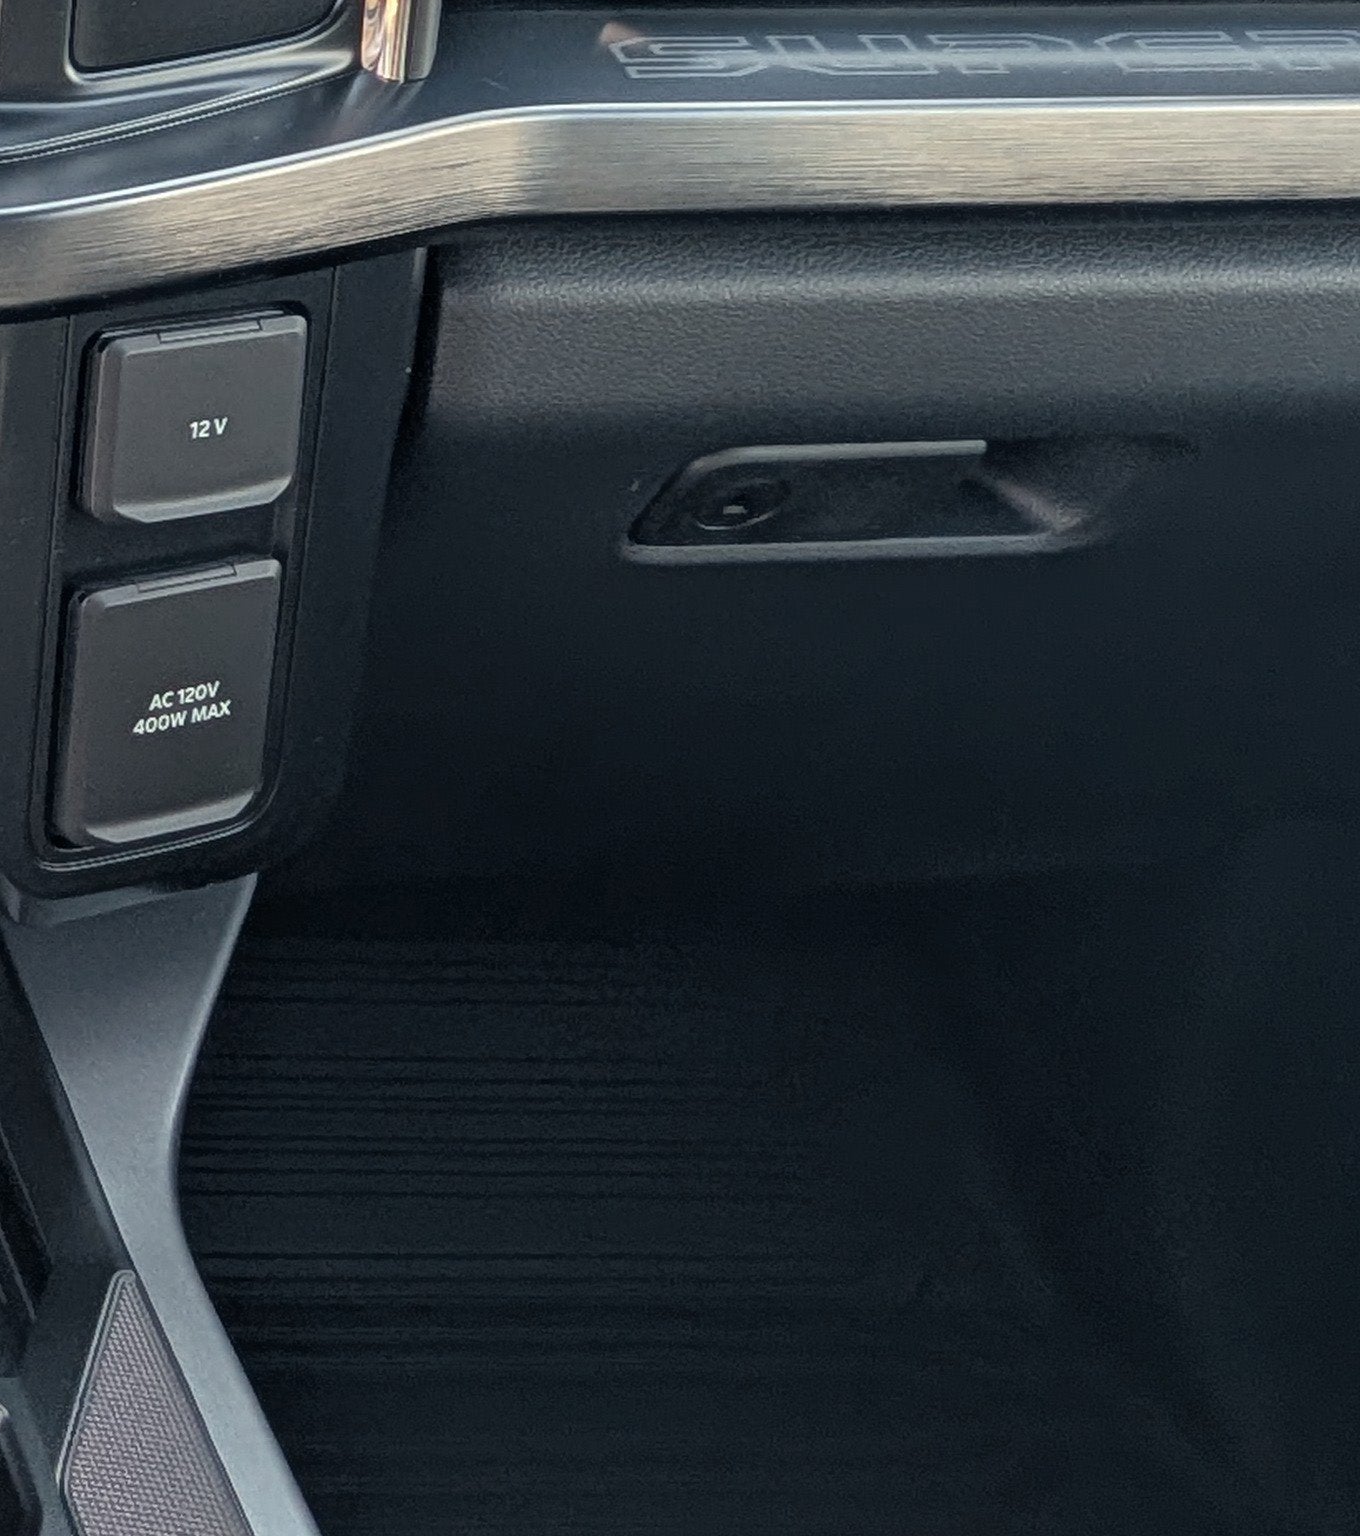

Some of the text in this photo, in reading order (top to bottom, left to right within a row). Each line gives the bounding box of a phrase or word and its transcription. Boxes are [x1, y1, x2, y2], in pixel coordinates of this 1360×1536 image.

[189, 417, 228, 439] 12 V
[148, 680, 221, 711] AC 120V
[132, 699, 232, 735] 400W MAX
